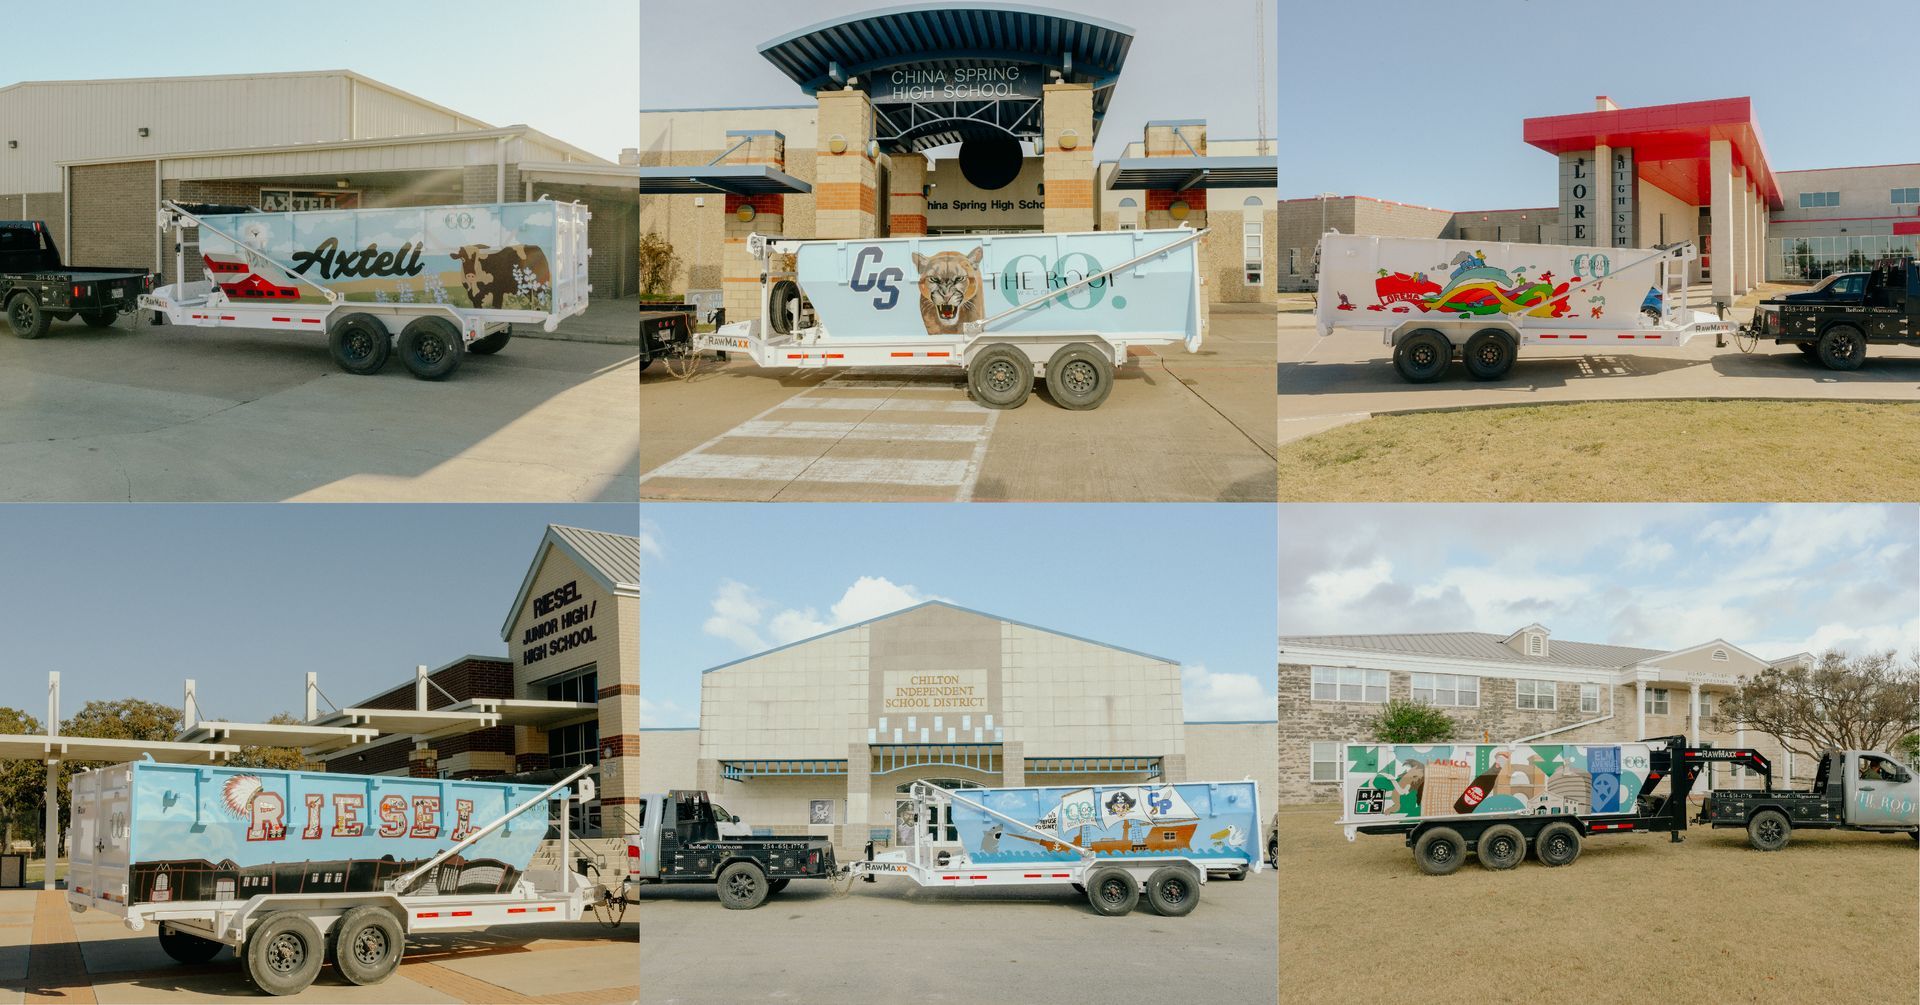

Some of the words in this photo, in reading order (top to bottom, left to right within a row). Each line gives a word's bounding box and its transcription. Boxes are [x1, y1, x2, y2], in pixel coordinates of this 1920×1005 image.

[892, 70, 945, 84] CHINA
[954, 66, 1019, 82] SPRING
[893, 85, 934, 99] HIGH
[943, 82, 1020, 98] SCHOOL
[927, 200, 948, 210] hina
[952, 200, 987, 211] Spring
[991, 200, 1014, 211] High
[1018, 200, 1045, 210] Scho
[1573, 165, 1586, 238] LORE
[1618, 214, 1626, 245] SCH
[286, 237, 425, 279] Axtell
[986, 271, 1034, 290] THE
[533, 580, 582, 619] RIESEL
[522, 618, 558, 645] JUNIOR
[561, 604, 588, 629] HIGH
[523, 643, 547, 666] HIGH
[549, 625, 597, 655] SCHOOL
[895, 686, 975, 697] INDEPENDENT
[910, 675, 960, 685] CHILTON
[885, 698, 930, 708] SCHOOL
[933, 697, 985, 708] DISTRICT
[247, 791, 482, 844] RIESEL
